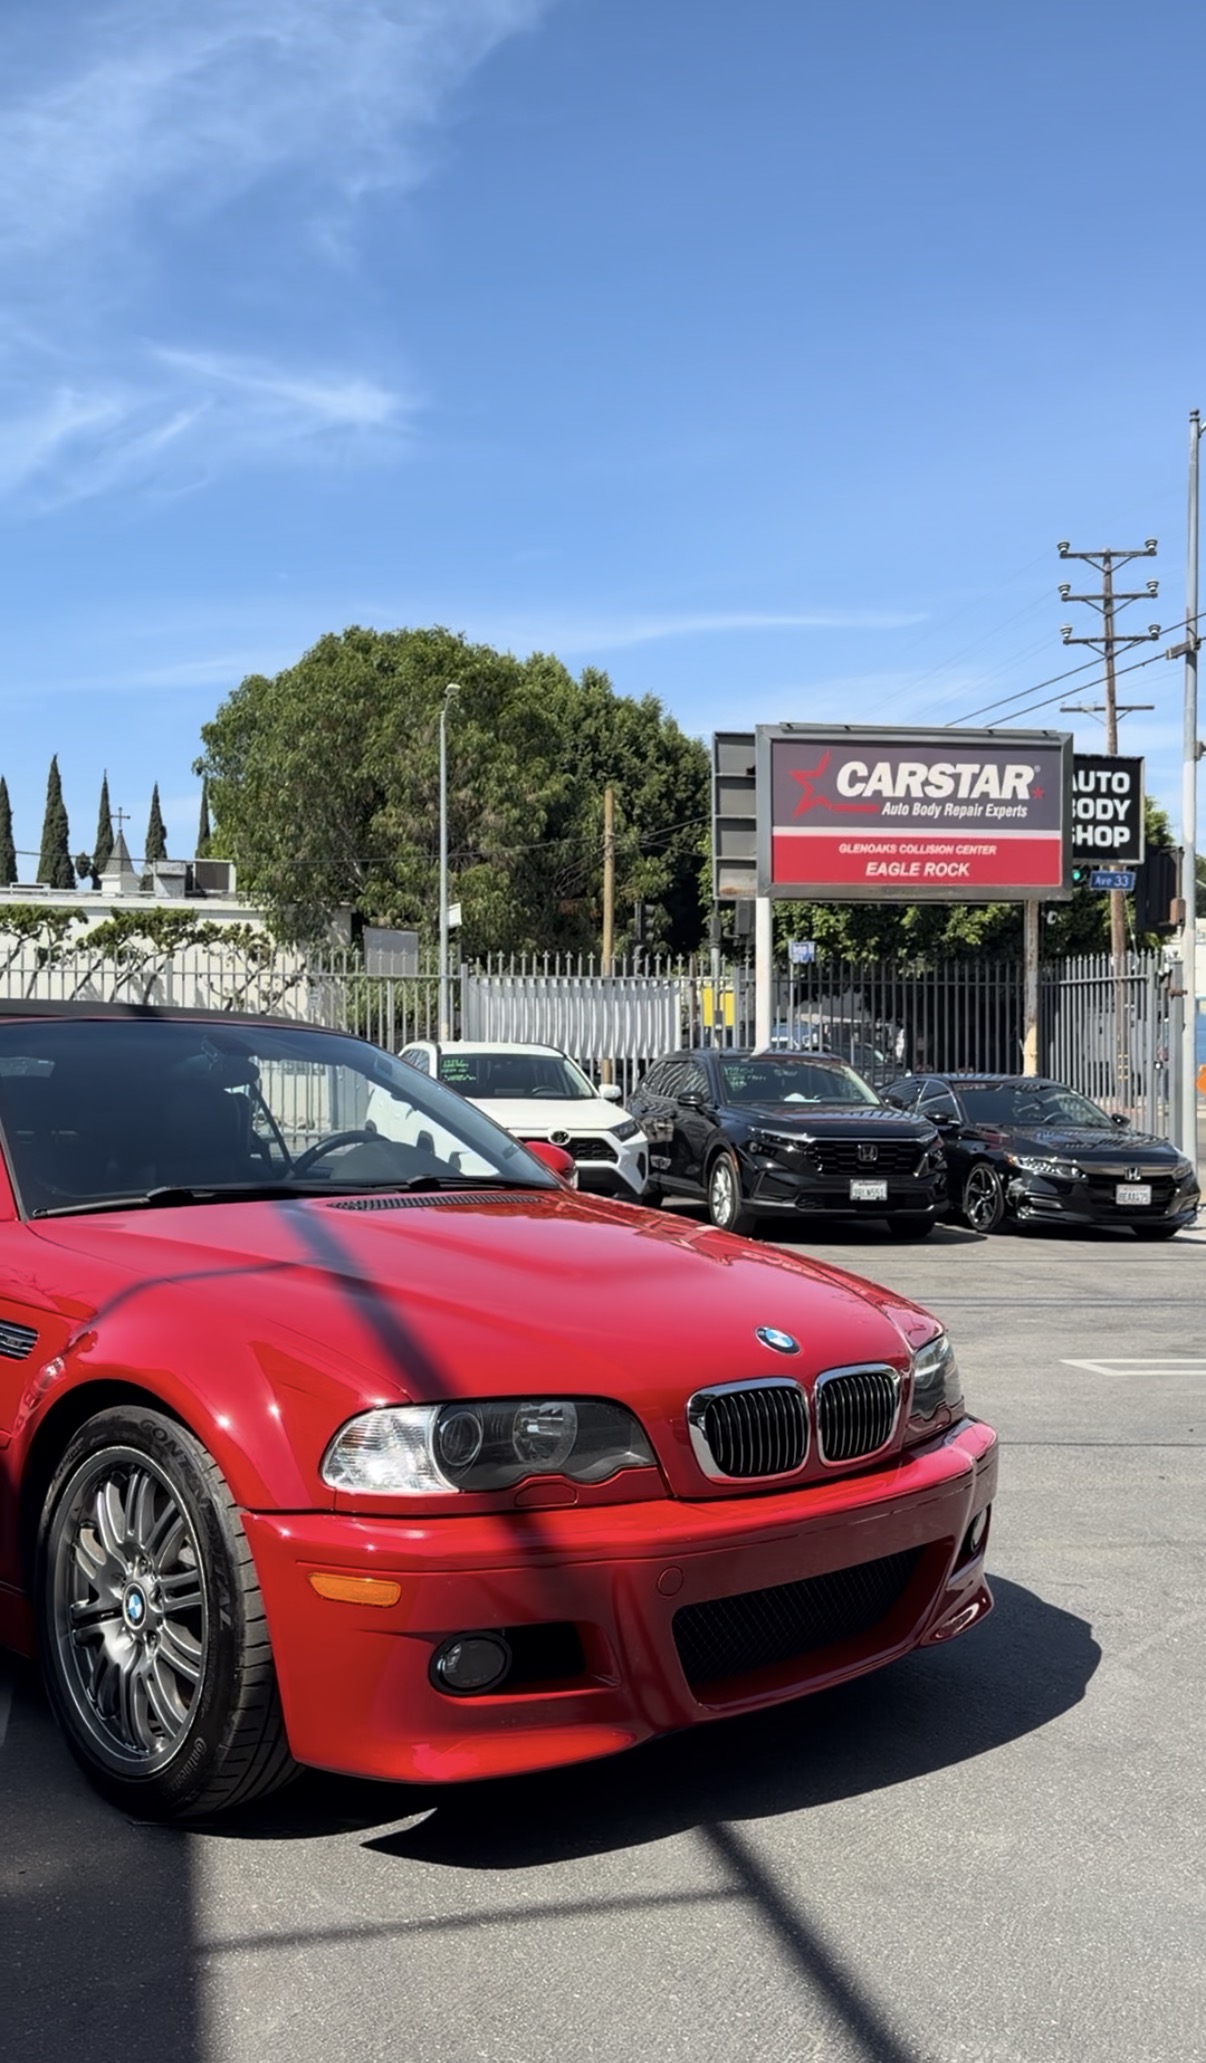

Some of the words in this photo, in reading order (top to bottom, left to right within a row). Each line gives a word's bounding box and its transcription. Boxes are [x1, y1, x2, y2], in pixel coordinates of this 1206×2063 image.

[836, 761, 1035, 799] CARSTAR
[1072, 770, 1130, 794] UTO
[882, 802, 908, 816] Auto
[912, 802, 942, 820] Body
[944, 803, 983, 819] Repair
[985, 803, 1028, 820] Experts
[1072, 797, 1131, 820] ODY
[1072, 825, 1130, 848] HOP
[839, 843, 897, 854] GLENOAKS
[899, 844, 954, 855] COLLISION
[955, 845, 997, 855] CENTER
[865, 861, 921, 877] EAGLE
[923, 862, 970, 877] ROCK
[1094, 875, 1113, 886] Ave
[1113, 875, 1129, 887] 33
